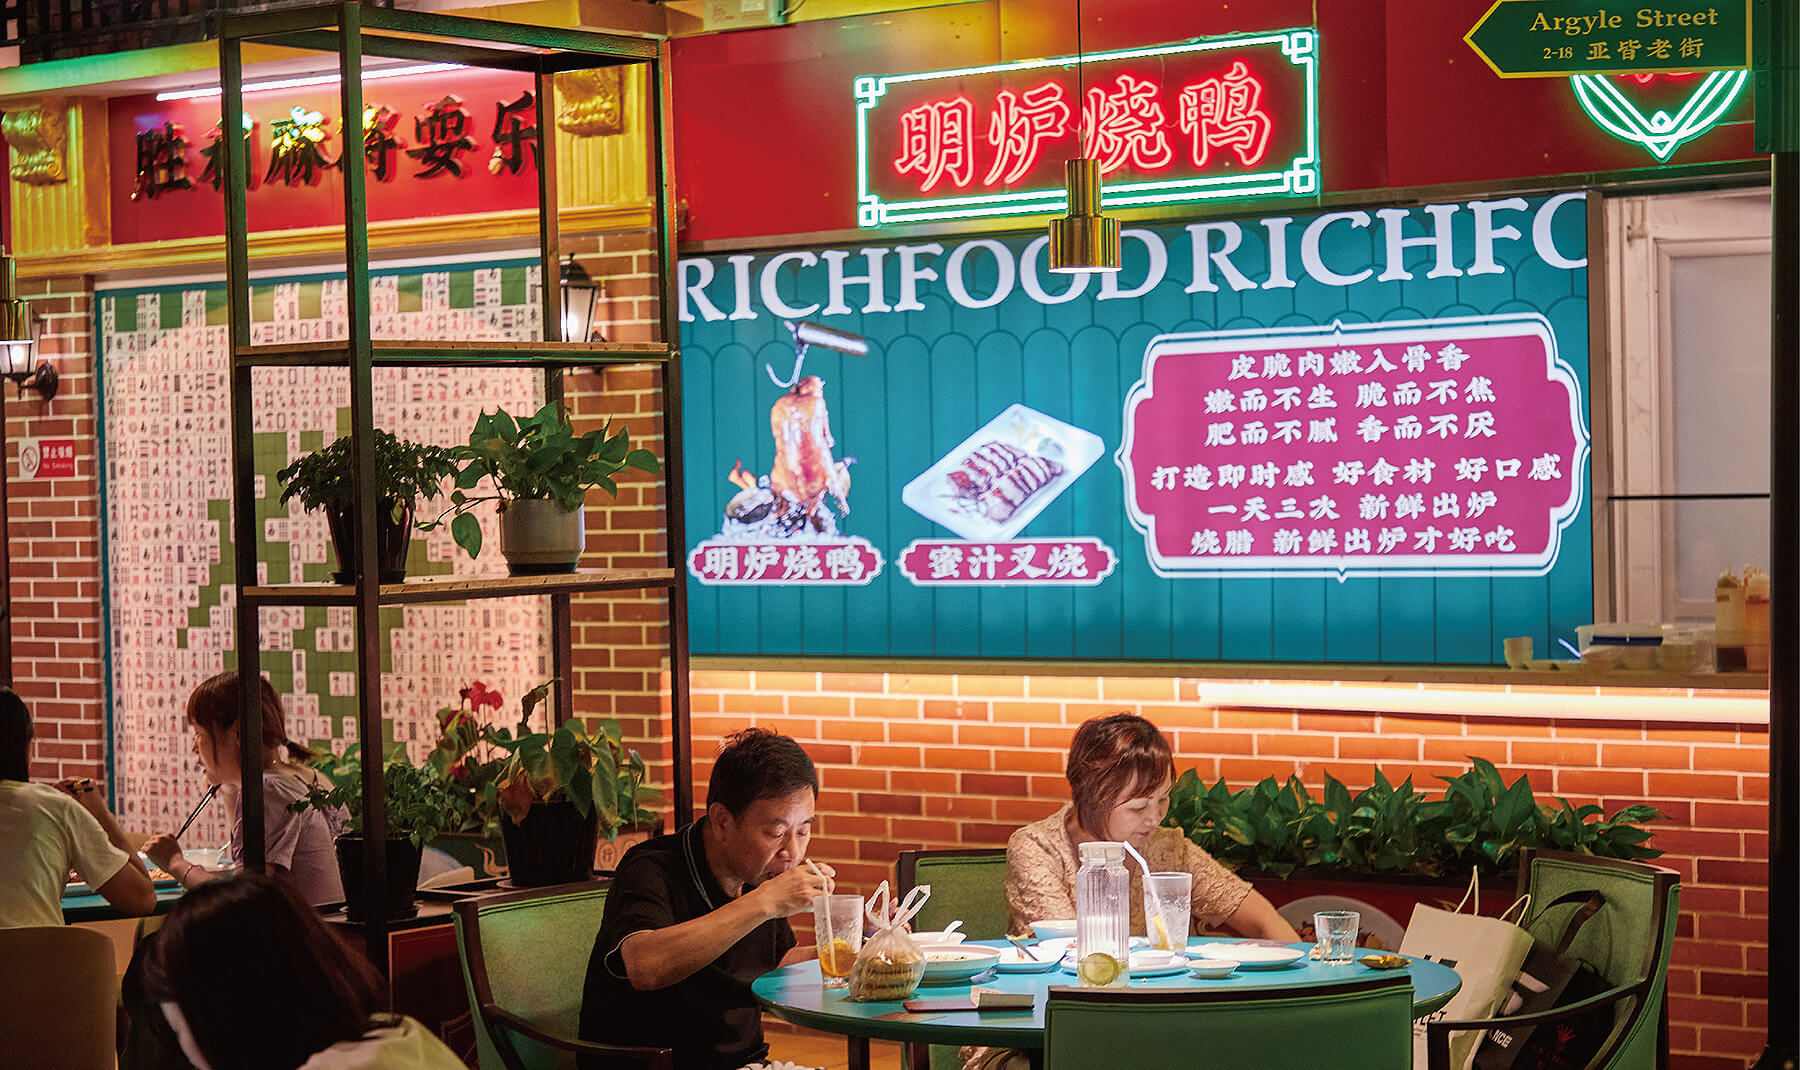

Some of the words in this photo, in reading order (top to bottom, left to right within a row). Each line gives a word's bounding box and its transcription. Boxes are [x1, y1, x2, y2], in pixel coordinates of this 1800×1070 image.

[1529, 10, 1623, 36] Argyle
[1636, 8, 1719, 28] Street
[1543, 47, 1573, 60] 2-18
[1586, 38, 1705, 61] 亚皆老街
[894, 62, 1271, 192] 明炉烧鸭
[678, 228, 1168, 322] RICHFOOD
[1228, 343, 1471, 381] 皮脆肉嫩入骨香
[1203, 383, 1338, 415] 嫩而不生
[1355, 376, 1497, 409] 脆而不焦
[1204, 417, 1339, 447] 肥而不腻
[1356, 410, 1497, 443] 香而不厌
[1151, 460, 1315, 491] 打造即时感
[1332, 457, 1437, 486] 好食材
[1454, 453, 1562, 482] 好口感
[1207, 494, 1341, 523] 一天三次
[1358, 490, 1498, 520] 新鲜出炉
[1190, 528, 1255, 555] 烧腊
[1272, 525, 1517, 555] 新鲜出炉才好吃
[702, 545, 864, 580] 明炉烧鸭
[928, 546, 1089, 580] 蜜汁叉烧
